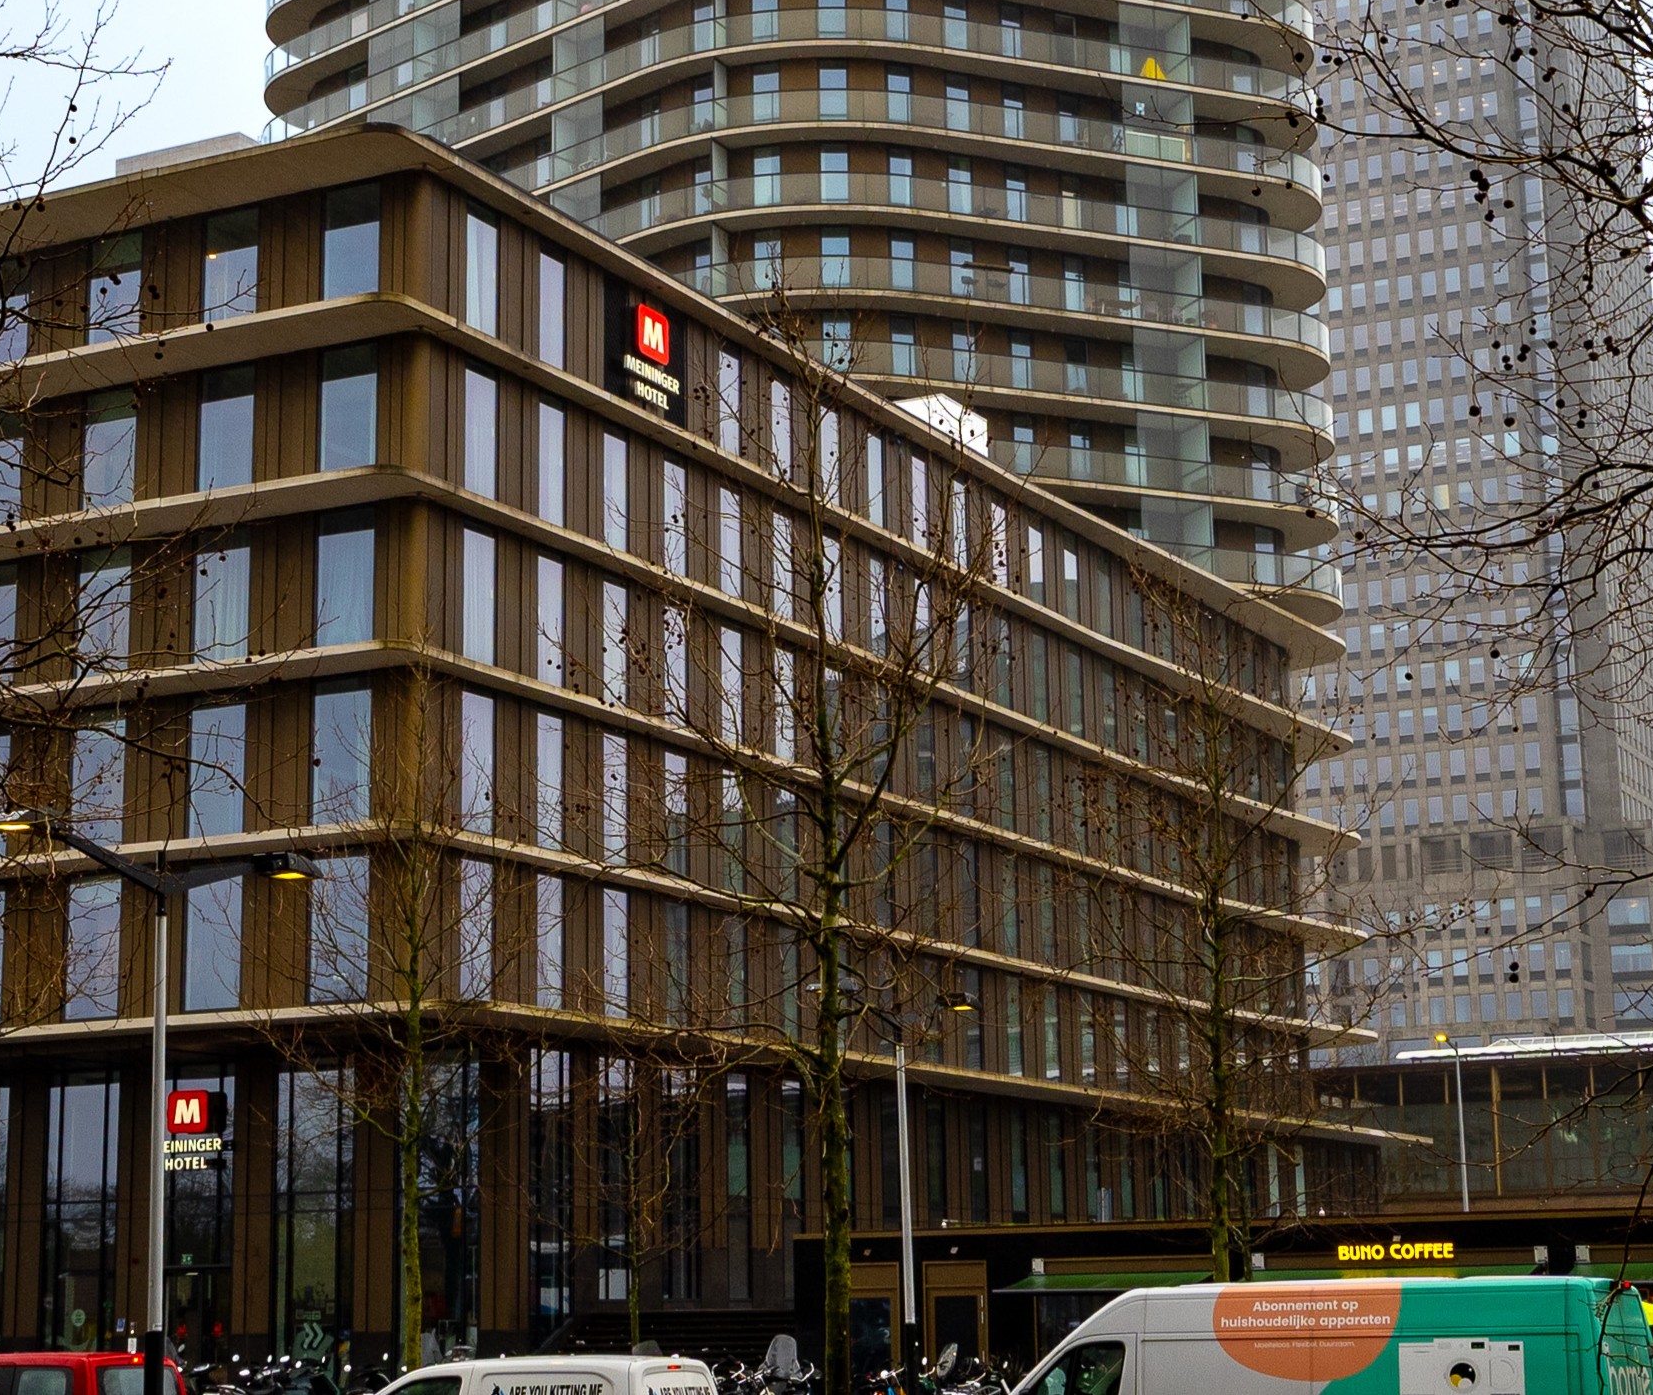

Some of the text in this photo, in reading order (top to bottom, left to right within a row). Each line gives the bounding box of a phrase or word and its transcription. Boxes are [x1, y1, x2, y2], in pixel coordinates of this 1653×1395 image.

[643, 316, 664, 354] M
[624, 354, 680, 395] MEININGER
[635, 381, 669, 410] HOTEL
[174, 1098, 200, 1124] M
[163, 1137, 222, 1154] EININGER
[164, 1156, 208, 1171] HOTEL
[1338, 1242, 1455, 1261] BUNO COFFEE
[1253, 1300, 1359, 1313] Abonnement op
[1220, 1314, 1391, 1330] huishoudelijke apparaten
[509, 1383, 603, 1395] ARE YOU KITTING ME
